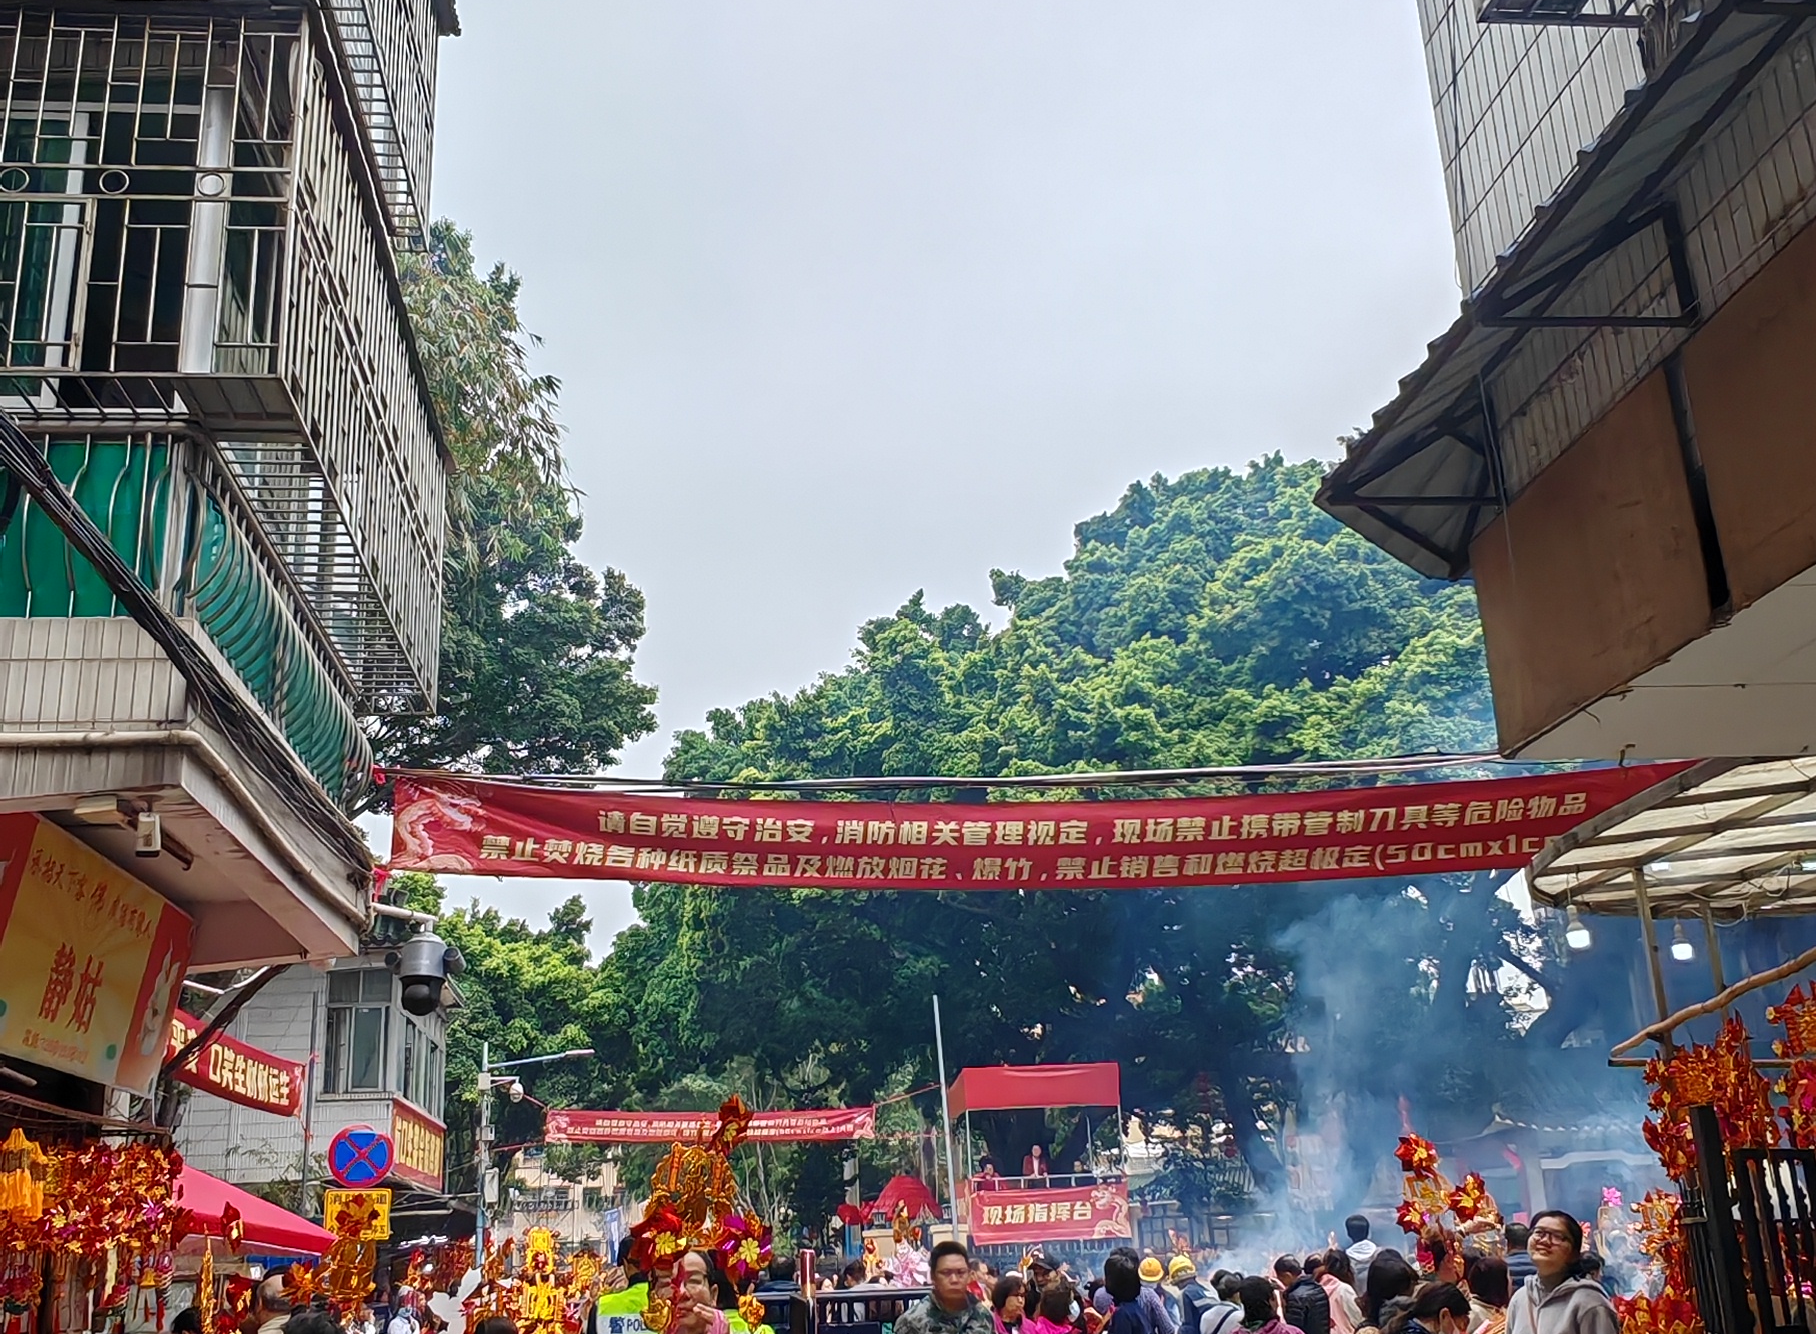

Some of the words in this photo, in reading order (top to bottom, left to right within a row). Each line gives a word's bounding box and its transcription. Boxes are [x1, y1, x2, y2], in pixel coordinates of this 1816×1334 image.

[38, 942, 104, 1034] 静姑
[981, 1200, 1092, 1226] 现场指挥台
